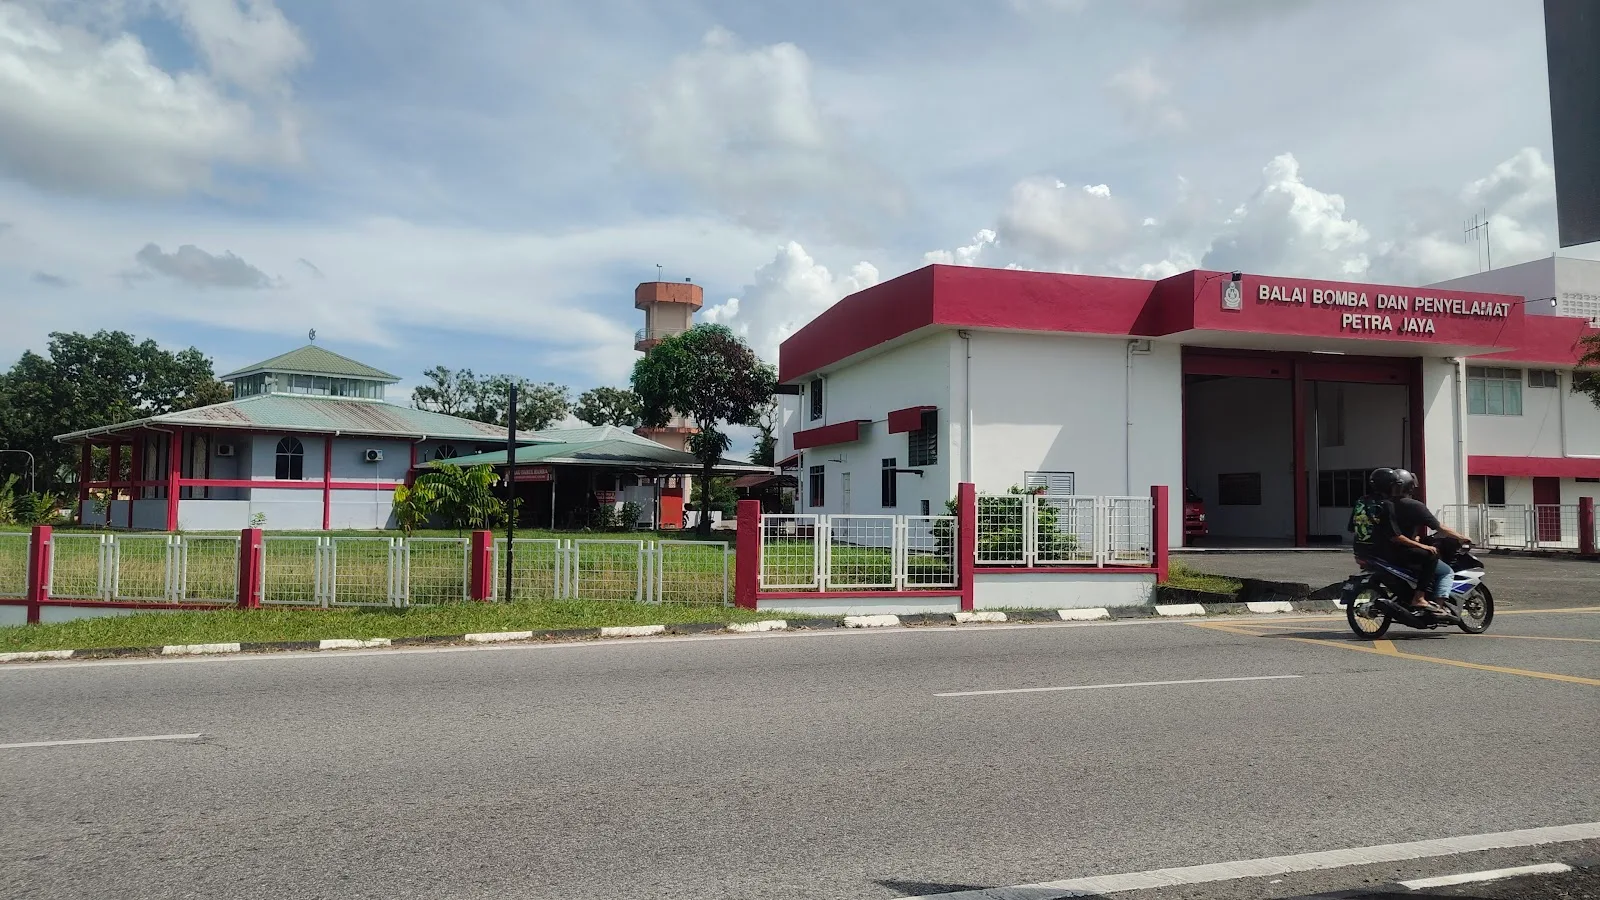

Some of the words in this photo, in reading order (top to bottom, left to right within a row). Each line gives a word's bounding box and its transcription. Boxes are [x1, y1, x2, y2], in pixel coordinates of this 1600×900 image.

[1259, 284, 1307, 303] BALAI
[1312, 288, 1369, 308] BOMBA
[1377, 293, 1408, 311] DAN
[1415, 296, 1510, 317] PENYELAMAT
[1342, 313, 1392, 331] PETRA
[1400, 317, 1435, 334] JAYA
